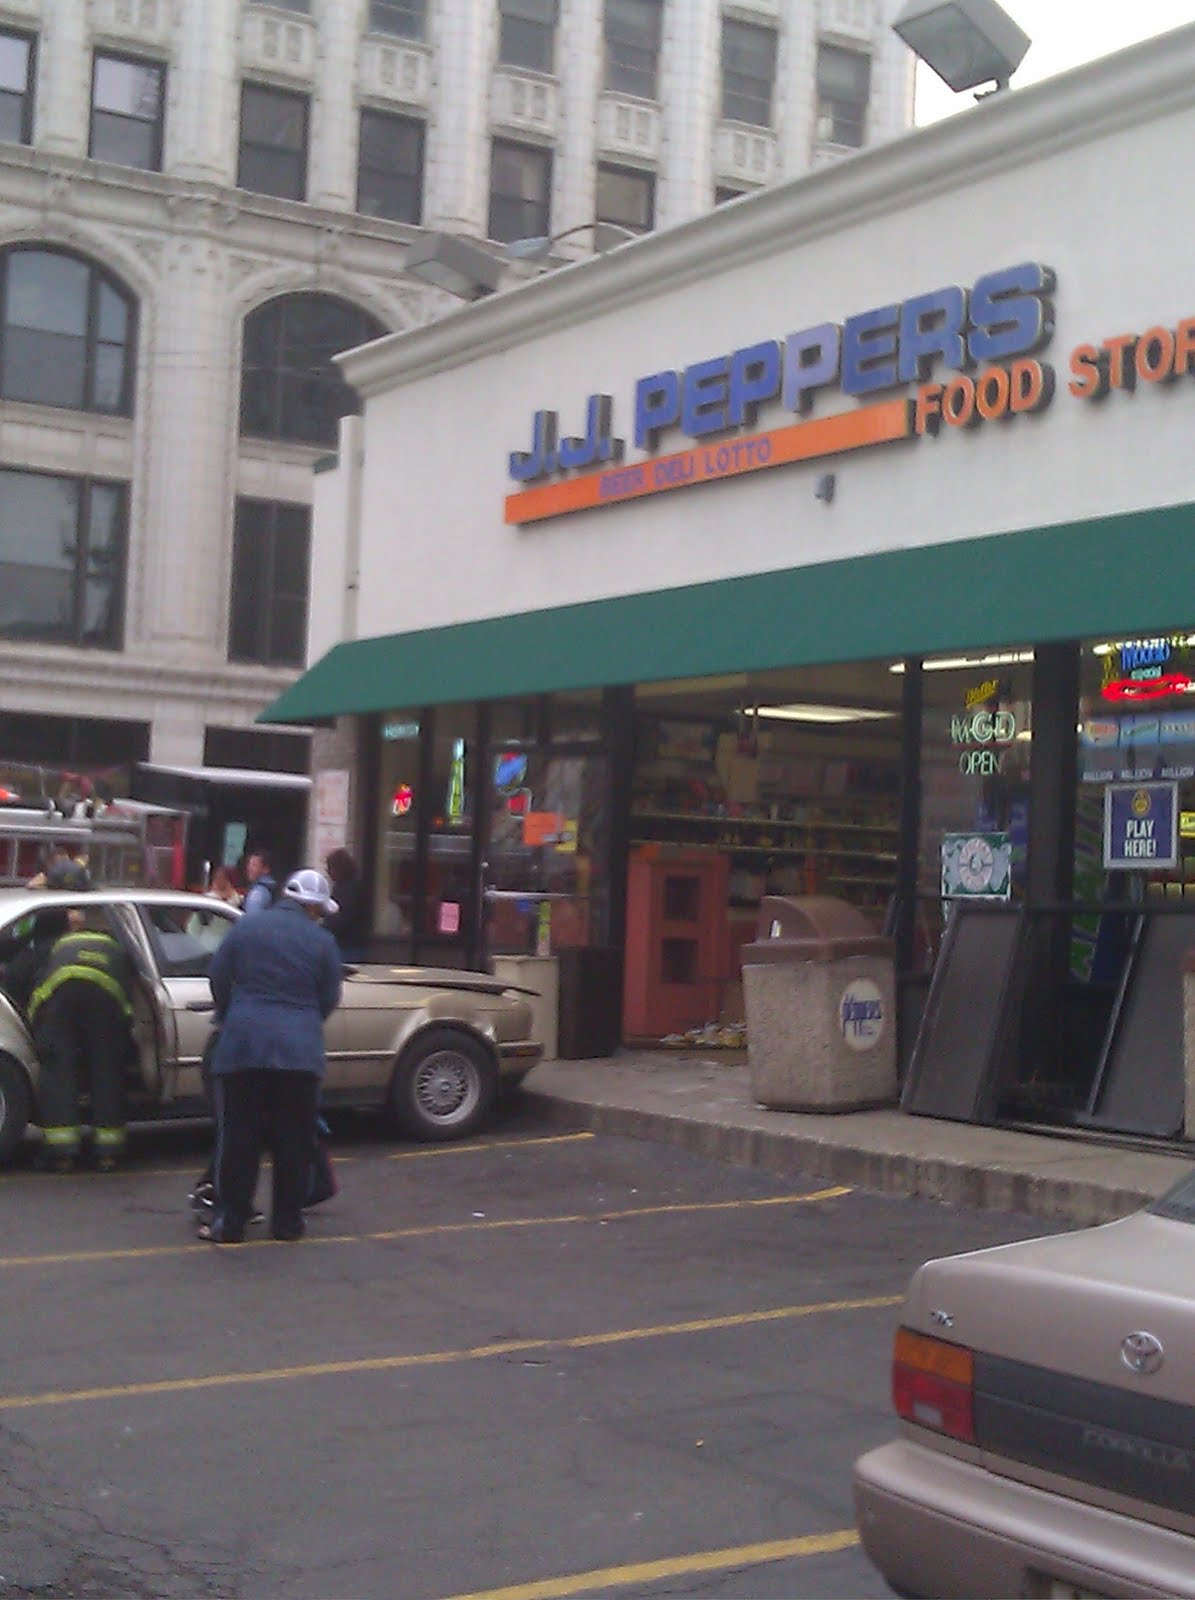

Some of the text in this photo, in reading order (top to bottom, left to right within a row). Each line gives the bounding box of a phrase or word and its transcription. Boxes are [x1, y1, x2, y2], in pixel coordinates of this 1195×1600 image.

[634, 261, 1055, 450] PEPPERS
[915, 359, 1050, 436] FOOD
[654, 449, 695, 486] DELI
[703, 437, 772, 475] LOTTO
[959, 750, 1006, 775] OPEN
[1126, 819, 1154, 838] PLAY
[1124, 839, 1157, 858] HERE!
